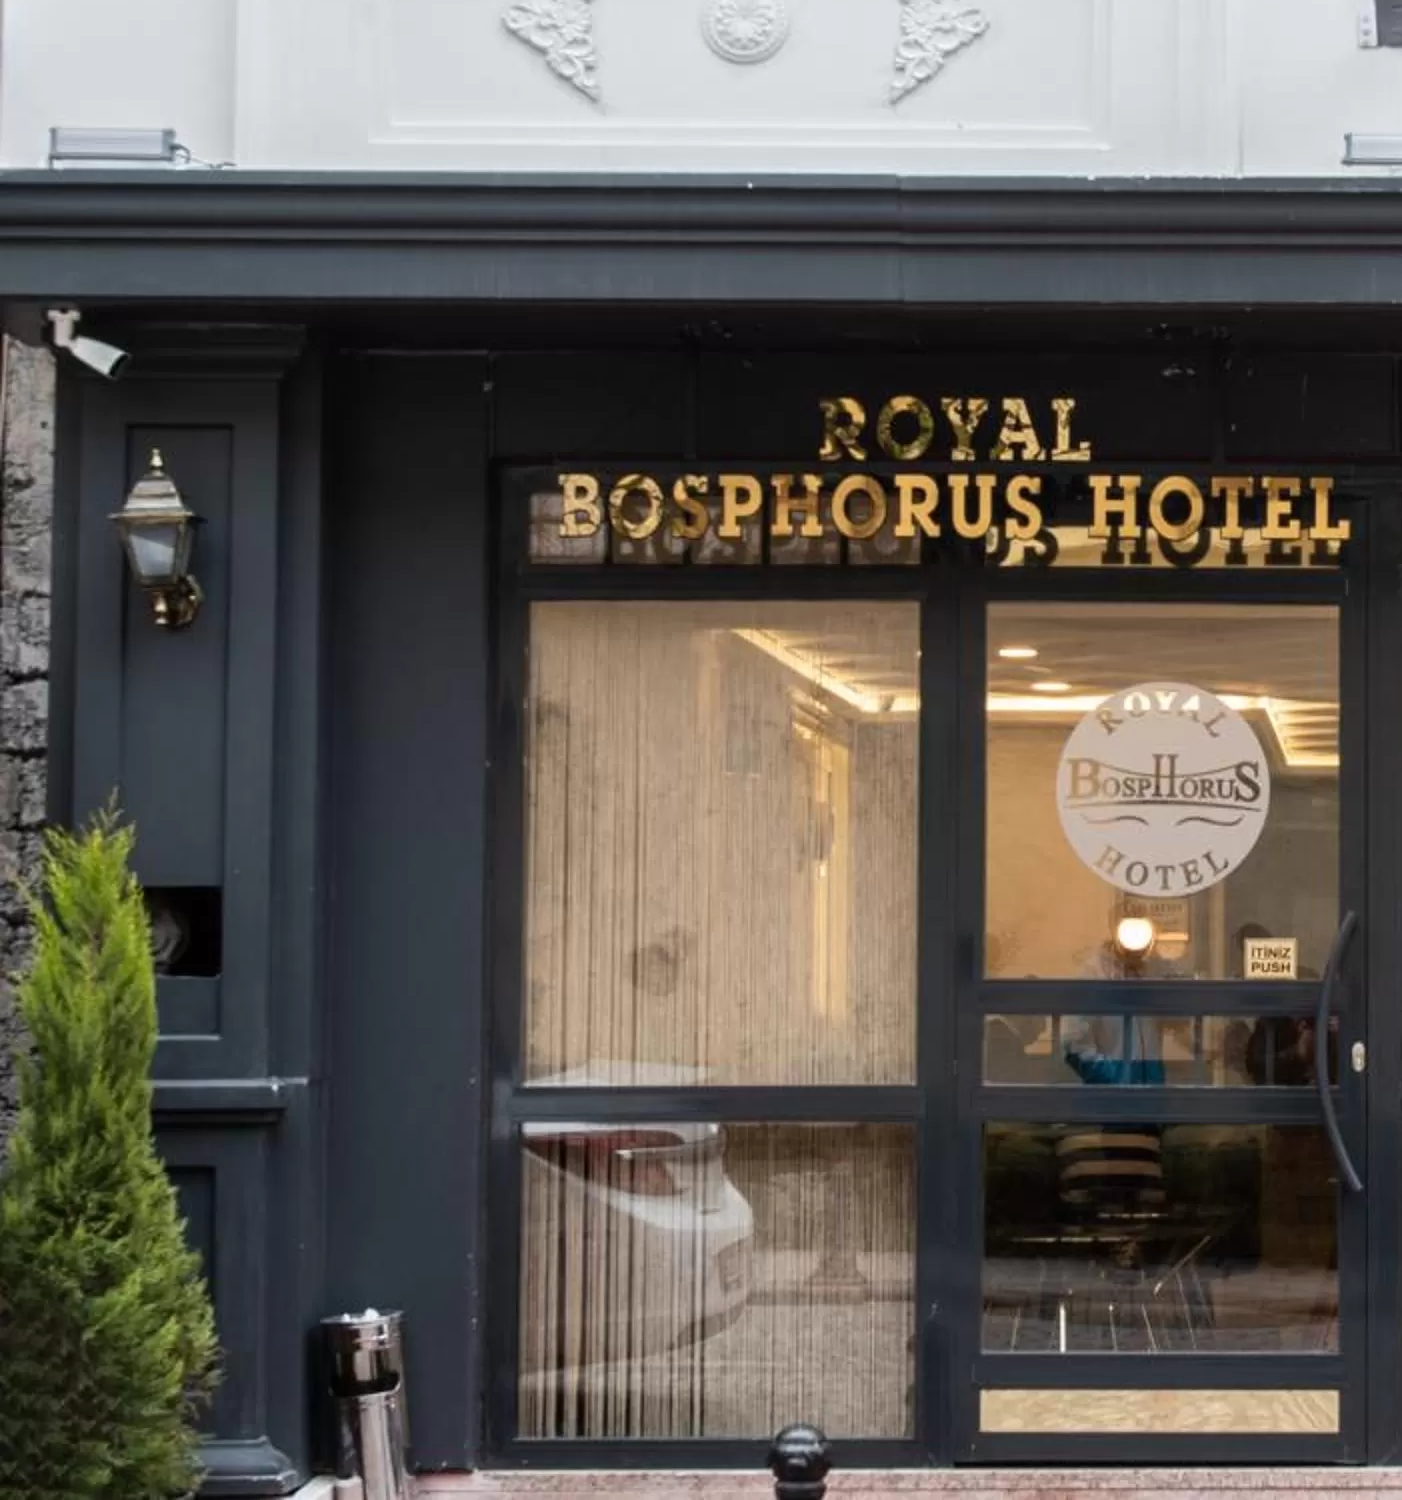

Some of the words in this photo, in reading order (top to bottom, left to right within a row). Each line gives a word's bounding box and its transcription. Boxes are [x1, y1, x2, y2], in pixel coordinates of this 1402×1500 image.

[819, 395, 1091, 461] ROYAL
[558, 473, 1043, 541] BOSPHORUS
[1088, 475, 1350, 541] HOTEL
[1096, 691, 1226, 739] ROYAL
[1066, 754, 1261, 803] BOSPHORUS
[1096, 846, 1230, 890] HOTEL
[1251, 962, 1291, 973] PUSH
